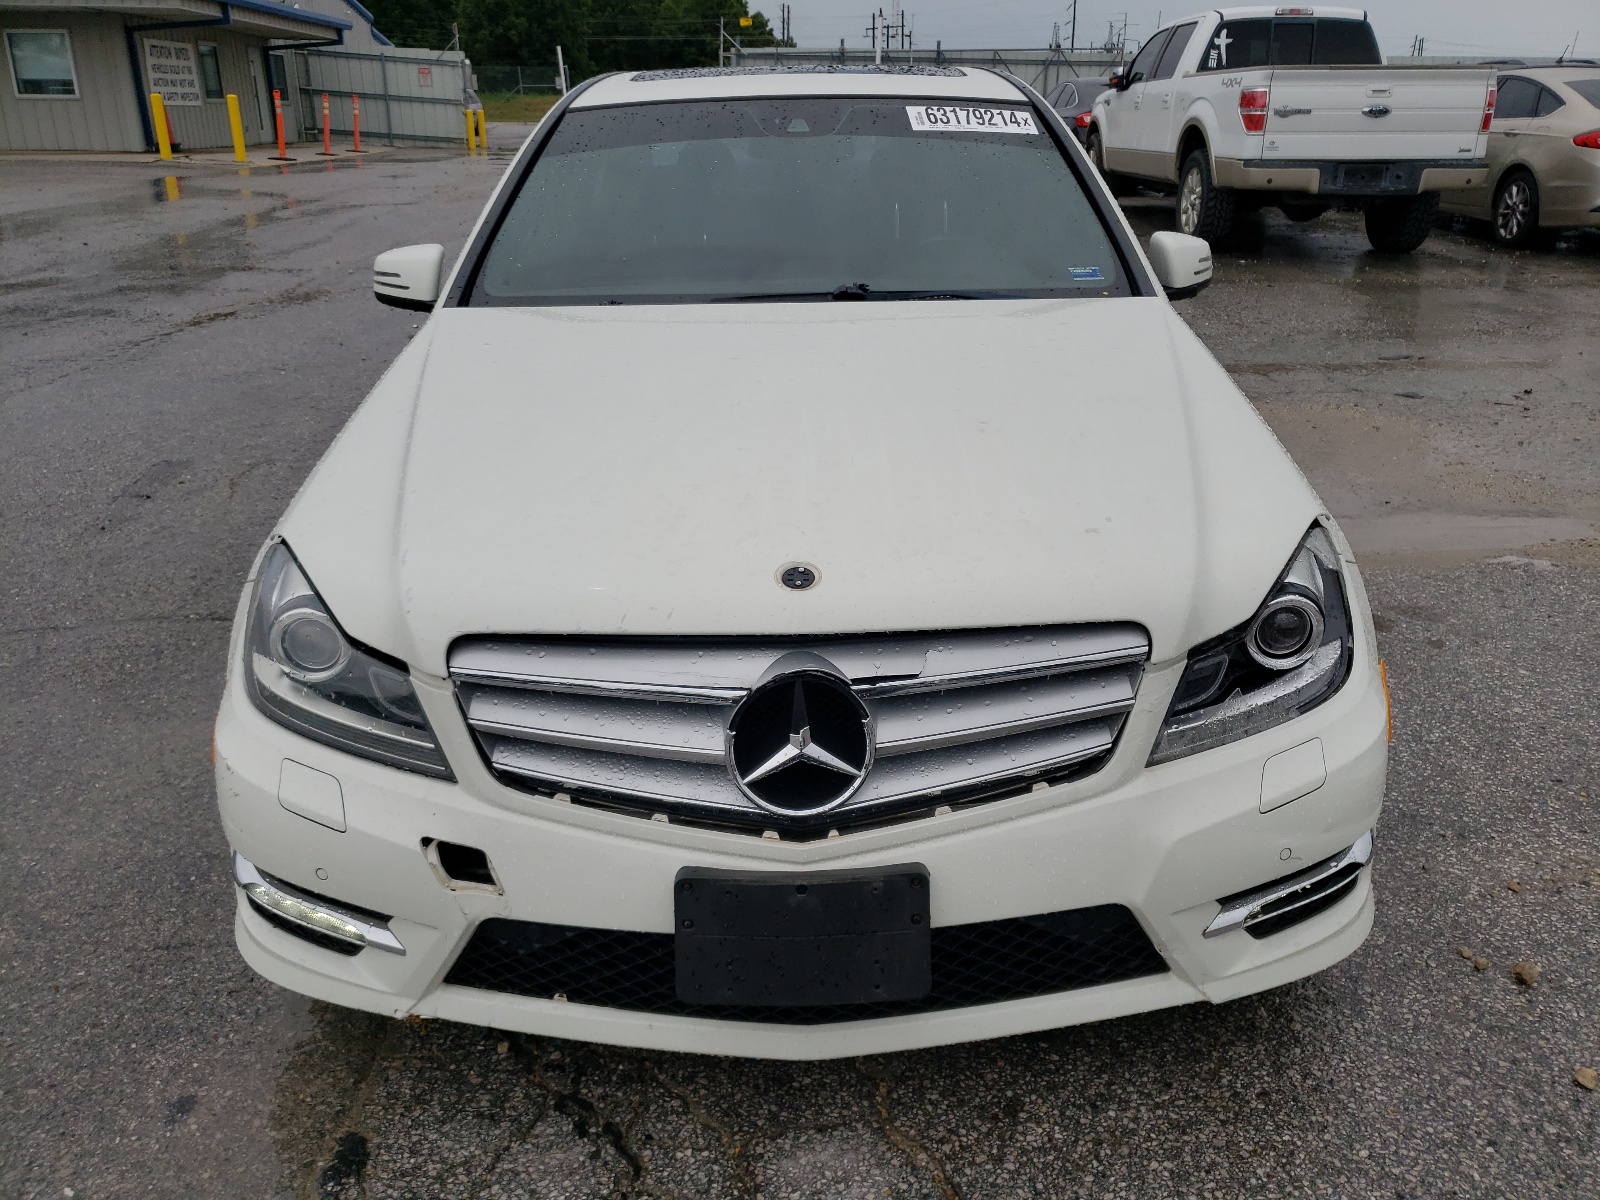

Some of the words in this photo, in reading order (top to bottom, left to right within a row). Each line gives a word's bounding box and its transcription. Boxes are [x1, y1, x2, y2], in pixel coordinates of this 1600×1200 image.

[149, 44, 172, 60] ATTENTION
[151, 63, 169, 74] VEHICLES
[169, 64, 180, 75] SOLD
[153, 77, 169, 88] AUCTION
[170, 79, 178, 88] MAY
[178, 79, 187, 88] NOT
[167, 91, 180, 102] SAFETY
[180, 92, 200, 102] INSPECTION
